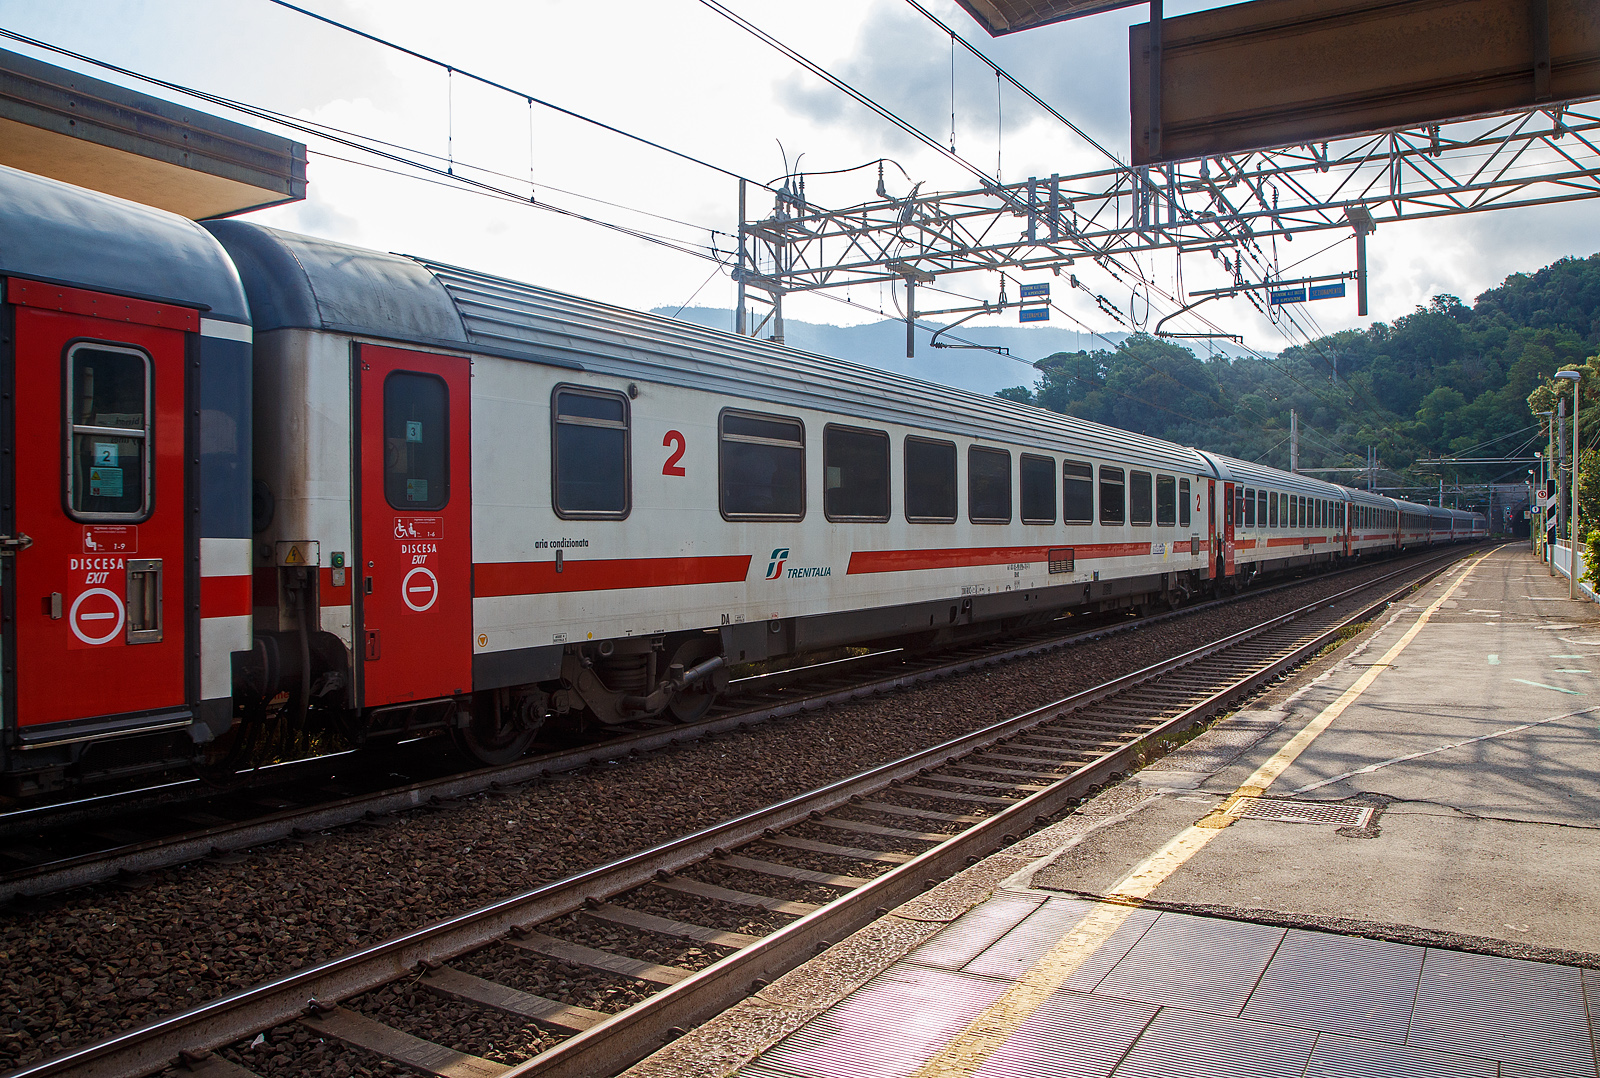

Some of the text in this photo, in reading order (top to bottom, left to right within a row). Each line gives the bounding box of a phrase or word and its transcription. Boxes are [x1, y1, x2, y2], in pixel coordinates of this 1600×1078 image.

[410, 427, 416, 437] 3
[102, 450, 111, 462] 2
[662, 429, 686, 477] 2
[1196, 493, 1201, 512] 2
[401, 543, 437, 554] DISCESA
[534, 537, 589, 549] aria condizionata
[70, 558, 124, 570] DISCESA
[411, 554, 428, 565] EXIT
[85, 572, 110, 584] EXIT
[787, 566, 831, 579] TRENITALIA
[721, 613, 731, 625] DA
